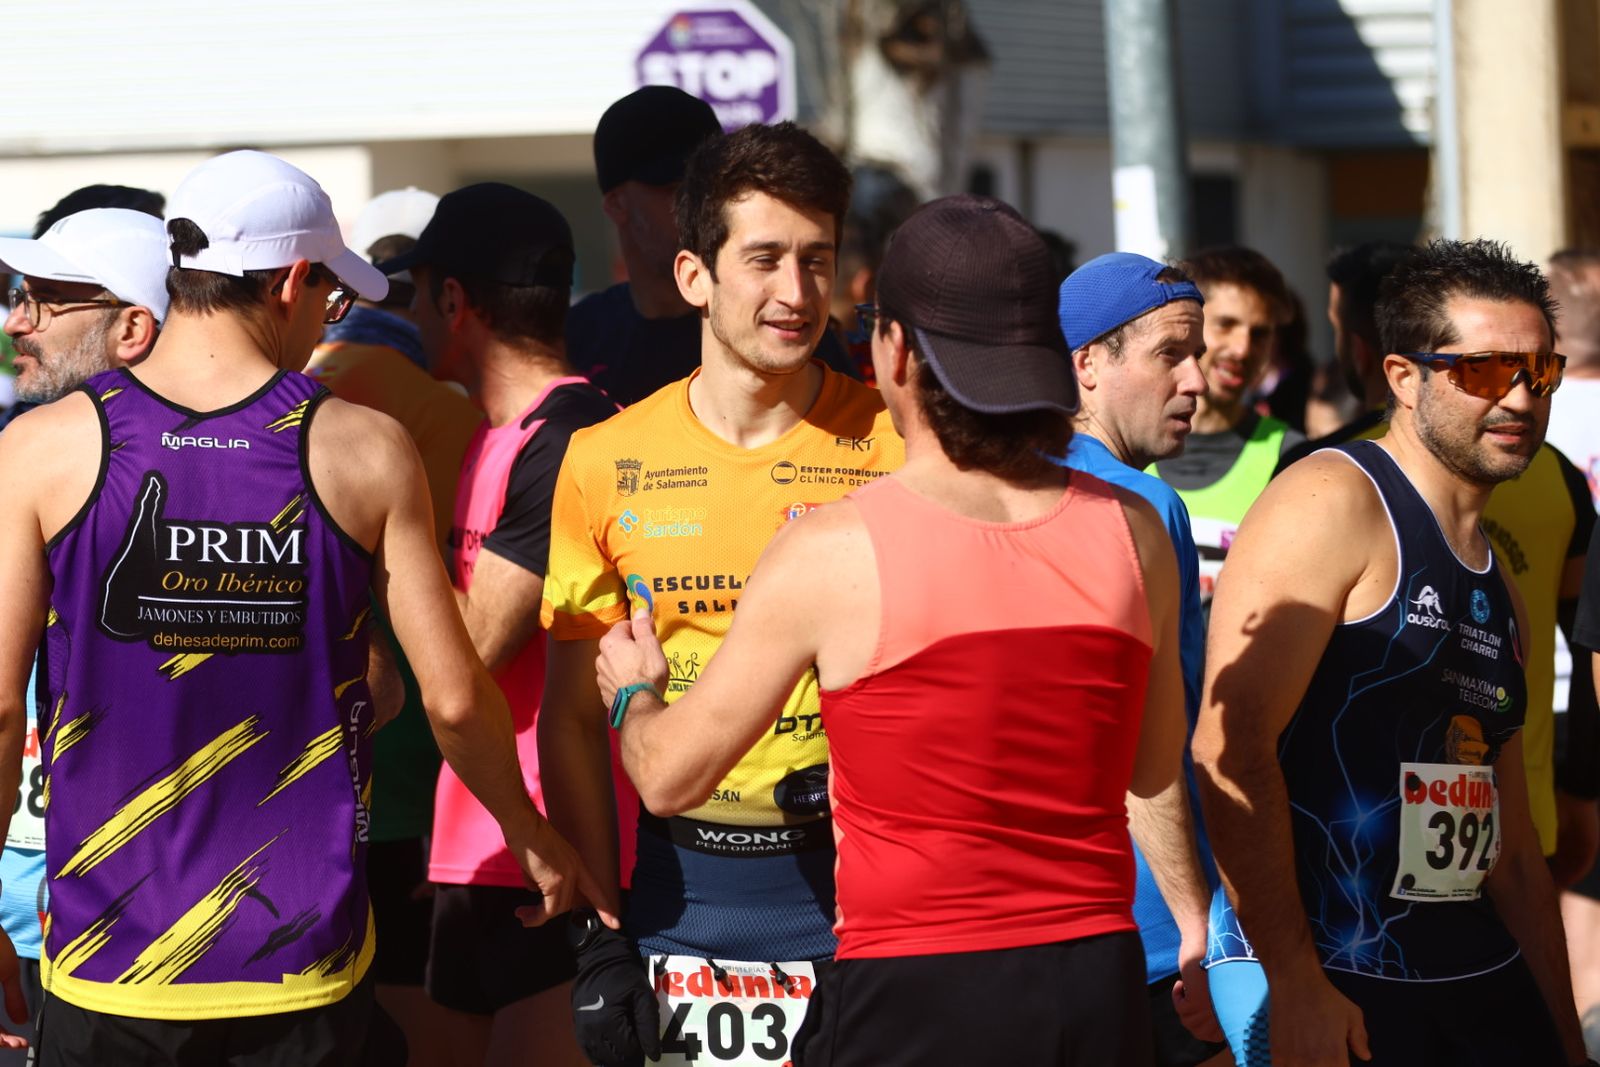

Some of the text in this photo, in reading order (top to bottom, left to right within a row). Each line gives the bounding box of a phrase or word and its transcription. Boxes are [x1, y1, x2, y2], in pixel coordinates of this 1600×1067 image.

[640, 50, 777, 99] STOP
[161, 431, 250, 450] MAGLIA
[644, 465, 708, 480] Ayuntamiento
[800, 465, 832, 474] ESTER
[642, 479, 708, 491] de Salamanca
[800, 474, 872, 487] CLÍNICA DEN
[644, 520, 702, 537] Sardón
[165, 525, 304, 565] PRIM
[162, 570, 303, 593] Oro Ibérico
[653, 575, 750, 592] ESCUEL
[137, 606, 301, 625] JAMONES Y EMBUTIDOS
[153, 632, 300, 650] dehesadeprim.com
[1458, 623, 1502, 648] TRIATLON
[1460, 638, 1499, 660] CHARRO
[1459, 688, 1498, 712] TELECOM
[1404, 771, 1494, 809] bedun
[697, 828, 806, 844] WONG
[1425, 810, 1494, 871] 392
[696, 840, 803, 852] PERFORMAN
[660, 1001, 789, 1062] 403
